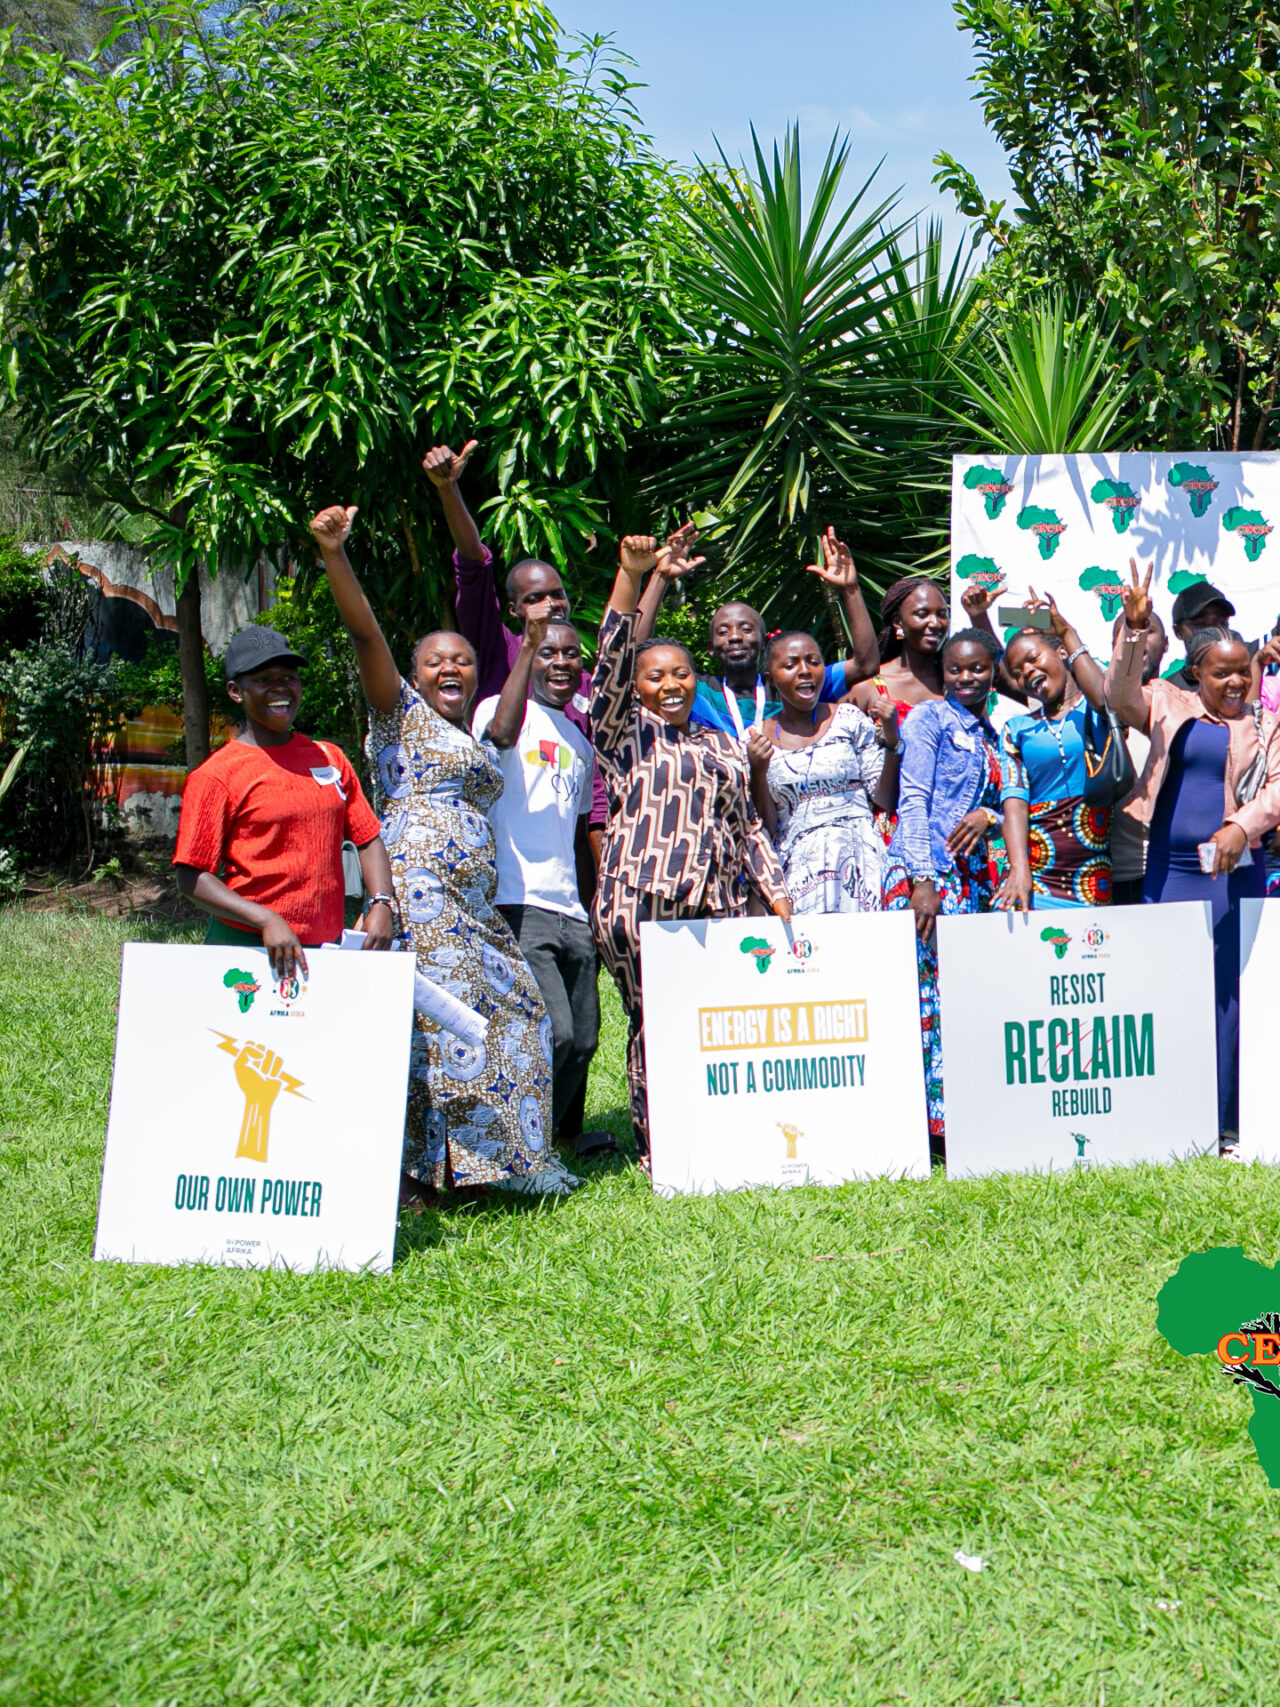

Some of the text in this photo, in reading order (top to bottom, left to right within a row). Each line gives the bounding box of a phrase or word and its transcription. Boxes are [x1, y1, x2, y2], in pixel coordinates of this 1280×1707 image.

[977, 484, 1014, 494] CECIC
[1182, 481, 1219, 491] CECIC
[1104, 497, 1141, 507] CECIC
[1030, 523, 1067, 533] CECIC
[1236, 524, 1274, 535] CECIC
[969, 572, 1006, 582] CECIC
[1050, 972, 1106, 1006] RESIST
[702, 1003, 867, 1048] ENERGY IS A RIGHT
[1004, 1013, 1155, 1085] RECLAIM
[706, 1055, 866, 1096] NOT A COMMODITY
[1052, 1087, 1112, 1117] REBUILD
[175, 1174, 323, 1217] OUR OWN POWER
[226, 1247, 252, 1255] AFRIKA
